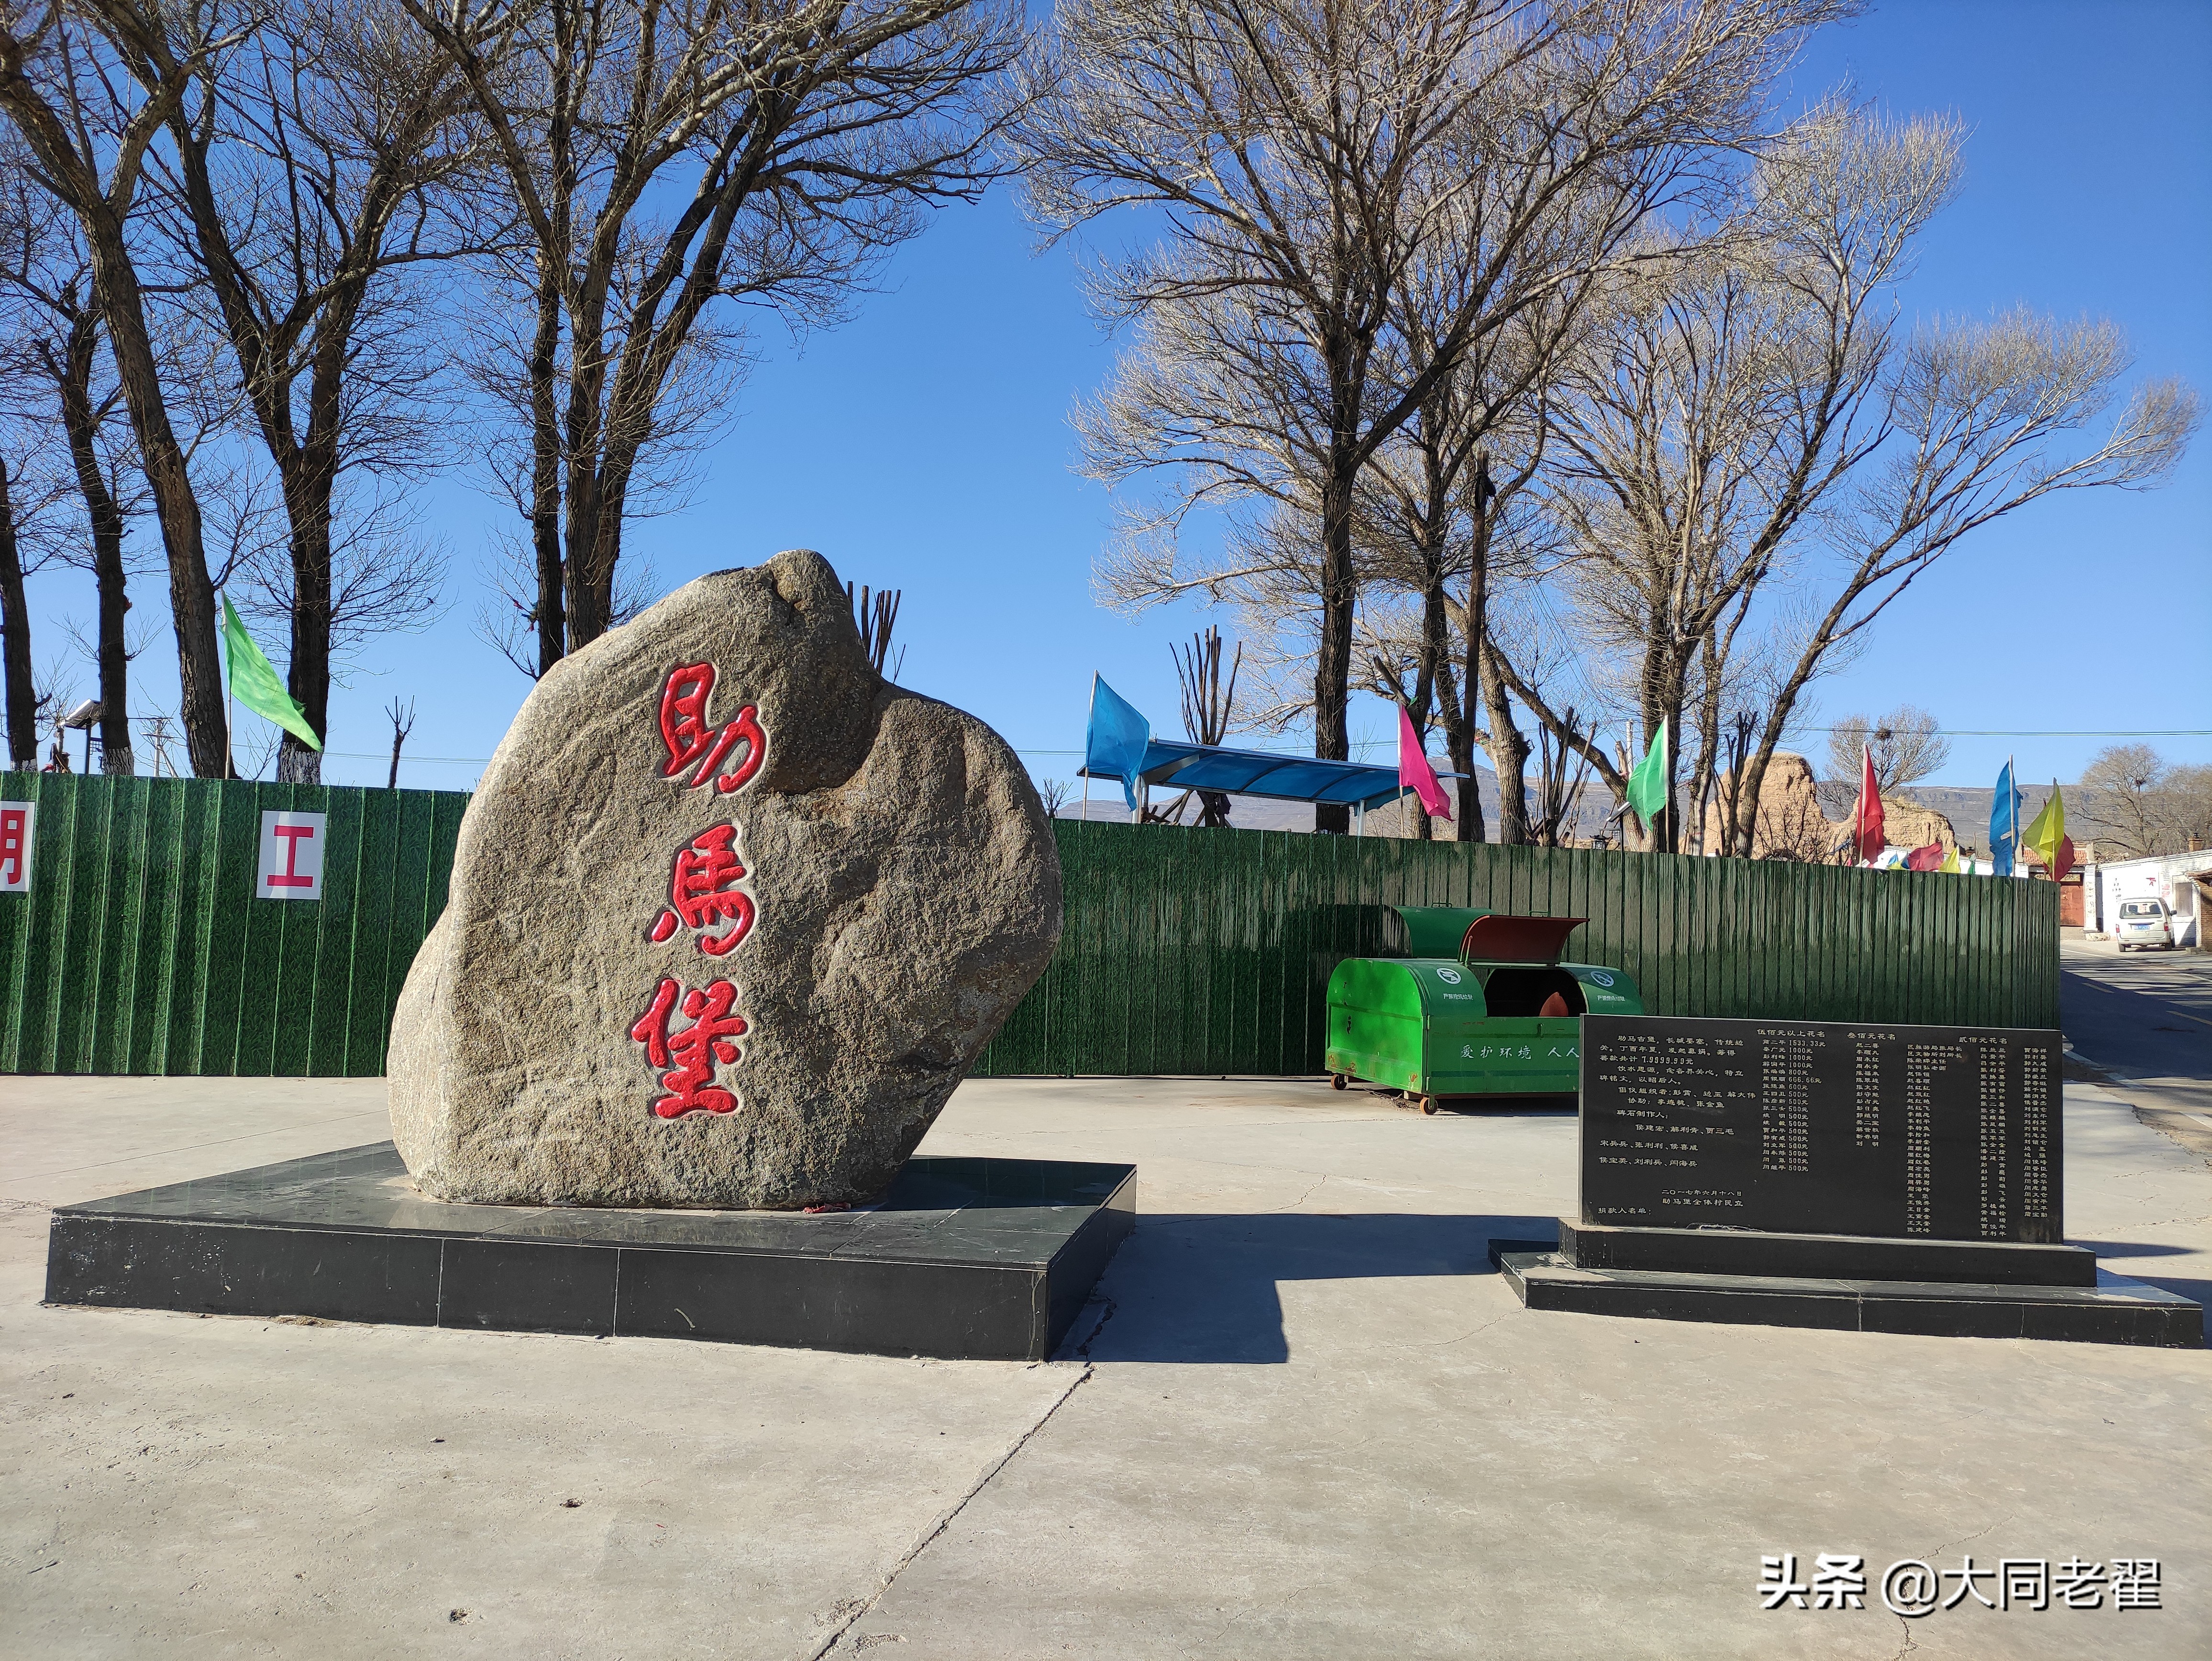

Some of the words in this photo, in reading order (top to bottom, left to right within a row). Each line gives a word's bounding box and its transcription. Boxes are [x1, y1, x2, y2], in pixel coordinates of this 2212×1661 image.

[266, 825, 314, 888] 工
[630, 661, 766, 1120] 助馬堡
[1547, 1046, 1580, 1058] 人人
